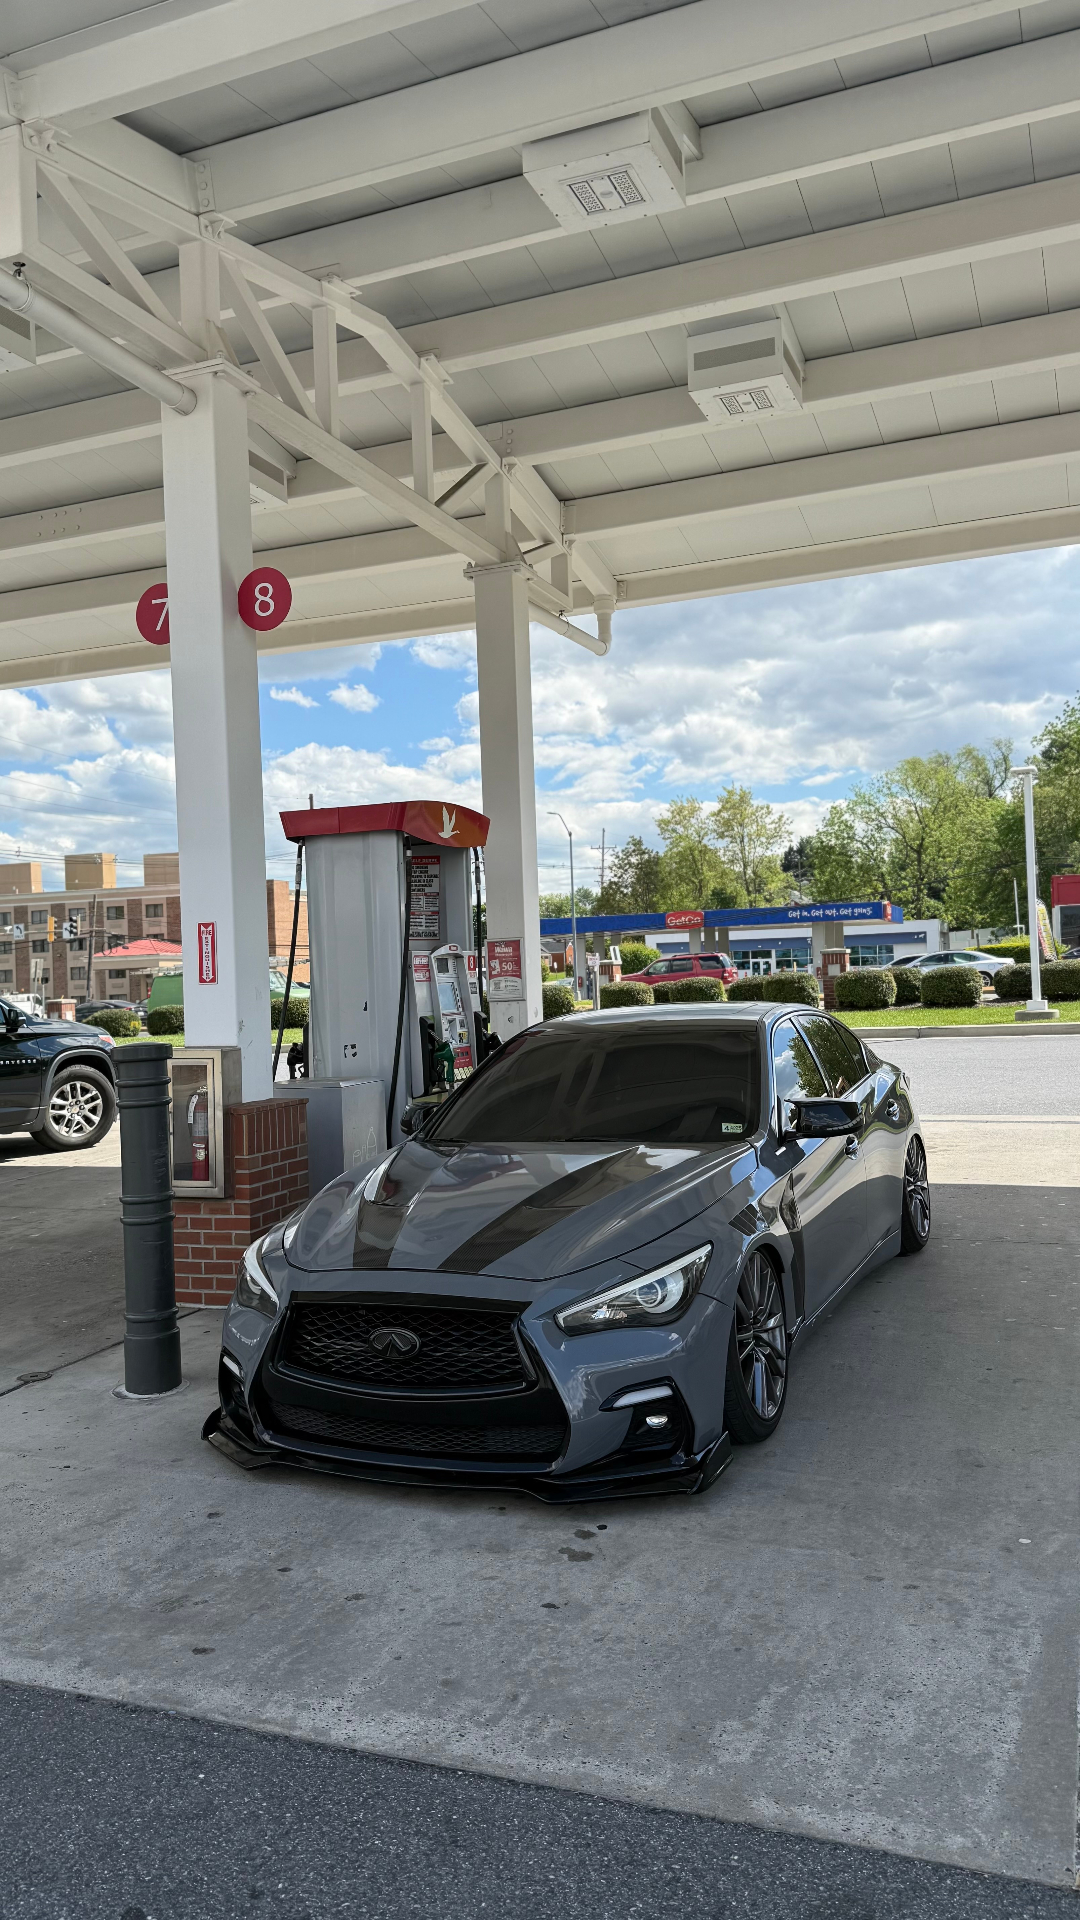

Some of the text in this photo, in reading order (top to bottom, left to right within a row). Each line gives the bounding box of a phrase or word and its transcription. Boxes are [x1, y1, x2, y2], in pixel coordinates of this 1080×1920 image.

[254, 582, 275, 617] 8
[152, 597, 169, 631] 7
[788, 909, 801, 919] Get
[811, 908, 823, 918] Get
[839, 907, 852, 917] Get
[469, 956, 474, 969] 8
